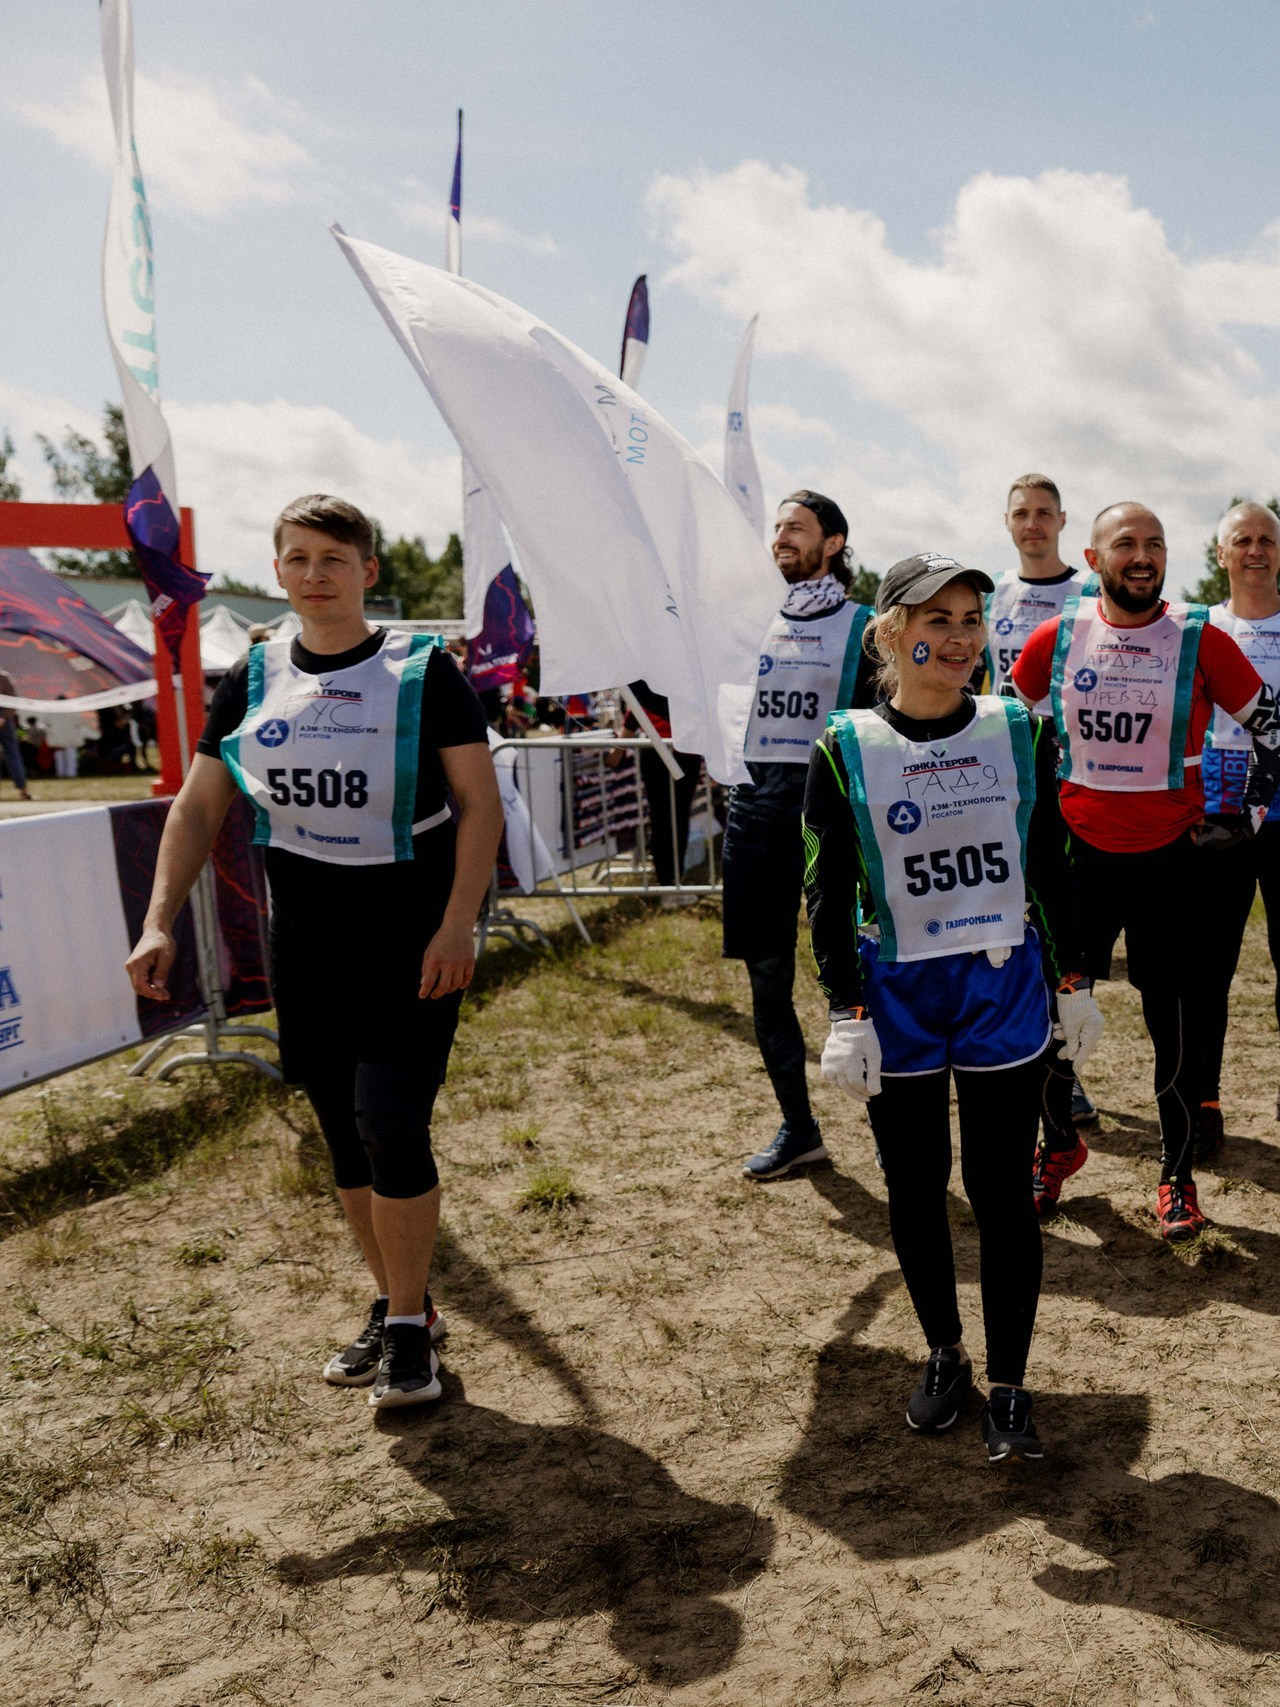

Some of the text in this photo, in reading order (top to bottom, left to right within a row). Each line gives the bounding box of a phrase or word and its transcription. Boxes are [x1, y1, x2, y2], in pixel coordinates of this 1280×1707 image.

[1121, 644, 1152, 653] ГЕРОЕВ
[322, 688, 362, 699] ГЕРОЕВ
[758, 690, 819, 721] 5503
[1078, 708, 1153, 744] 5507
[903, 756, 979, 774] ГОНКА ГЕРОЕВ
[267, 768, 369, 809] 5508
[930, 795, 1007, 811] АЭМ-ТЕХНОЛОГИИ
[931, 809, 964, 820] РОСАТОМ
[904, 841, 1010, 897] 5505
[945, 913, 1003, 930] ГАЗПРОМБАНК
